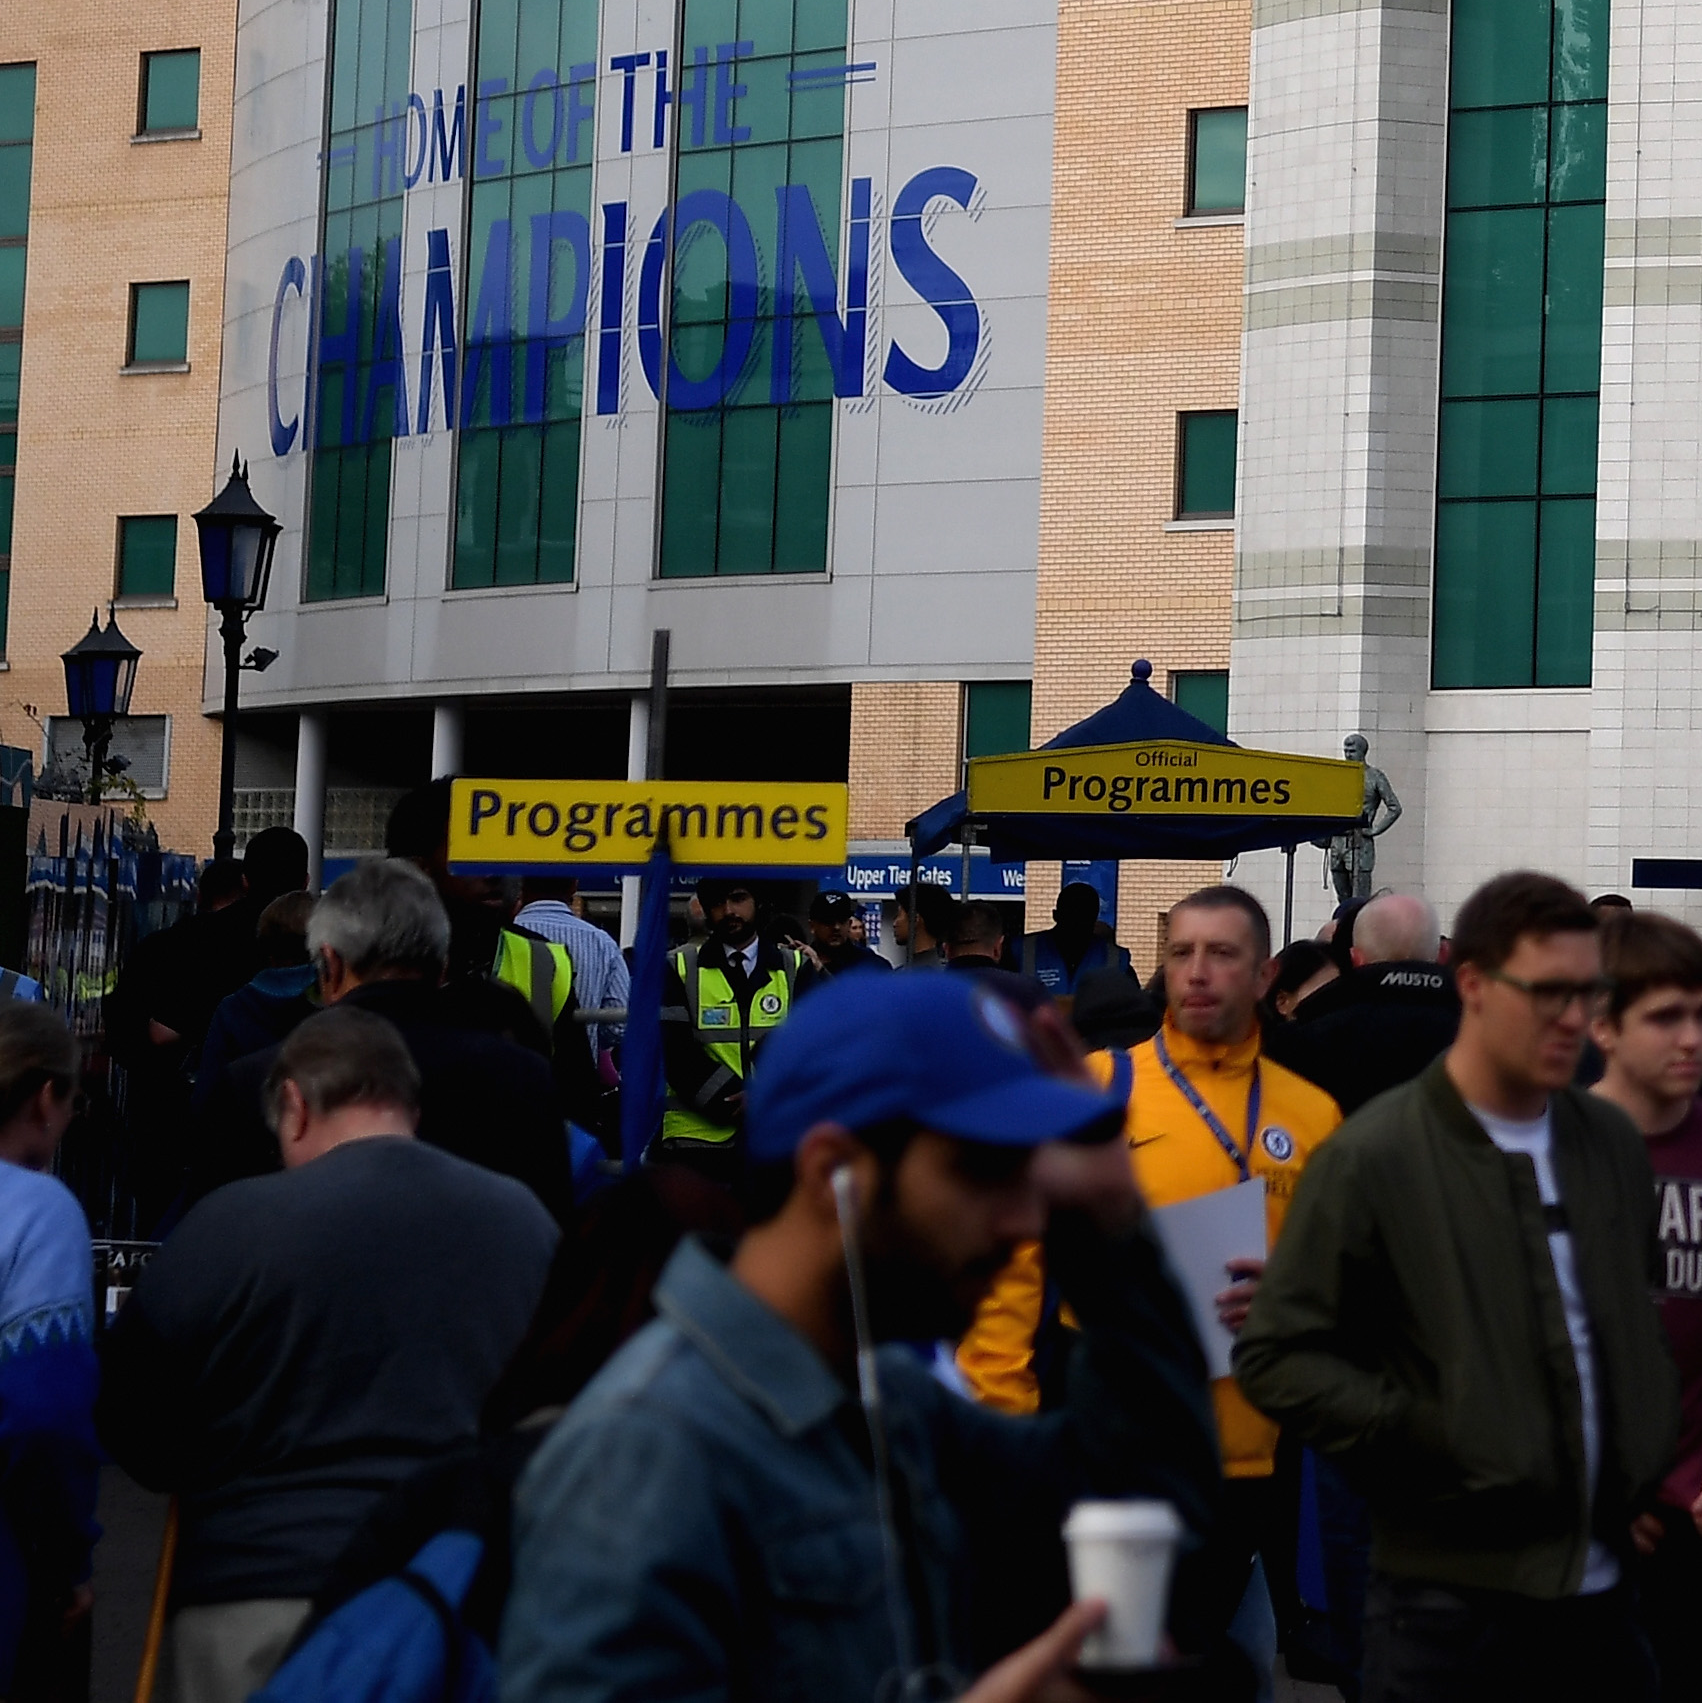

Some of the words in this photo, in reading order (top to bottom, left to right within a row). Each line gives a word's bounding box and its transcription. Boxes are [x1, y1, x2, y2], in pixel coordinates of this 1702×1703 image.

[372, 76, 508, 198] HOME
[521, 60, 596, 170] OF
[610, 40, 756, 154] THE
[267, 164, 982, 457] CHAMPIONS
[1134, 750, 1200, 769] Official
[1042, 767, 1291, 813] Programmes
[467, 789, 829, 853] Programmes
[847, 865, 885, 890] Upper
[888, 865, 911, 885] Tier
[916, 865, 953, 886] Gates
[1380, 971, 1443, 989] MUSTO
